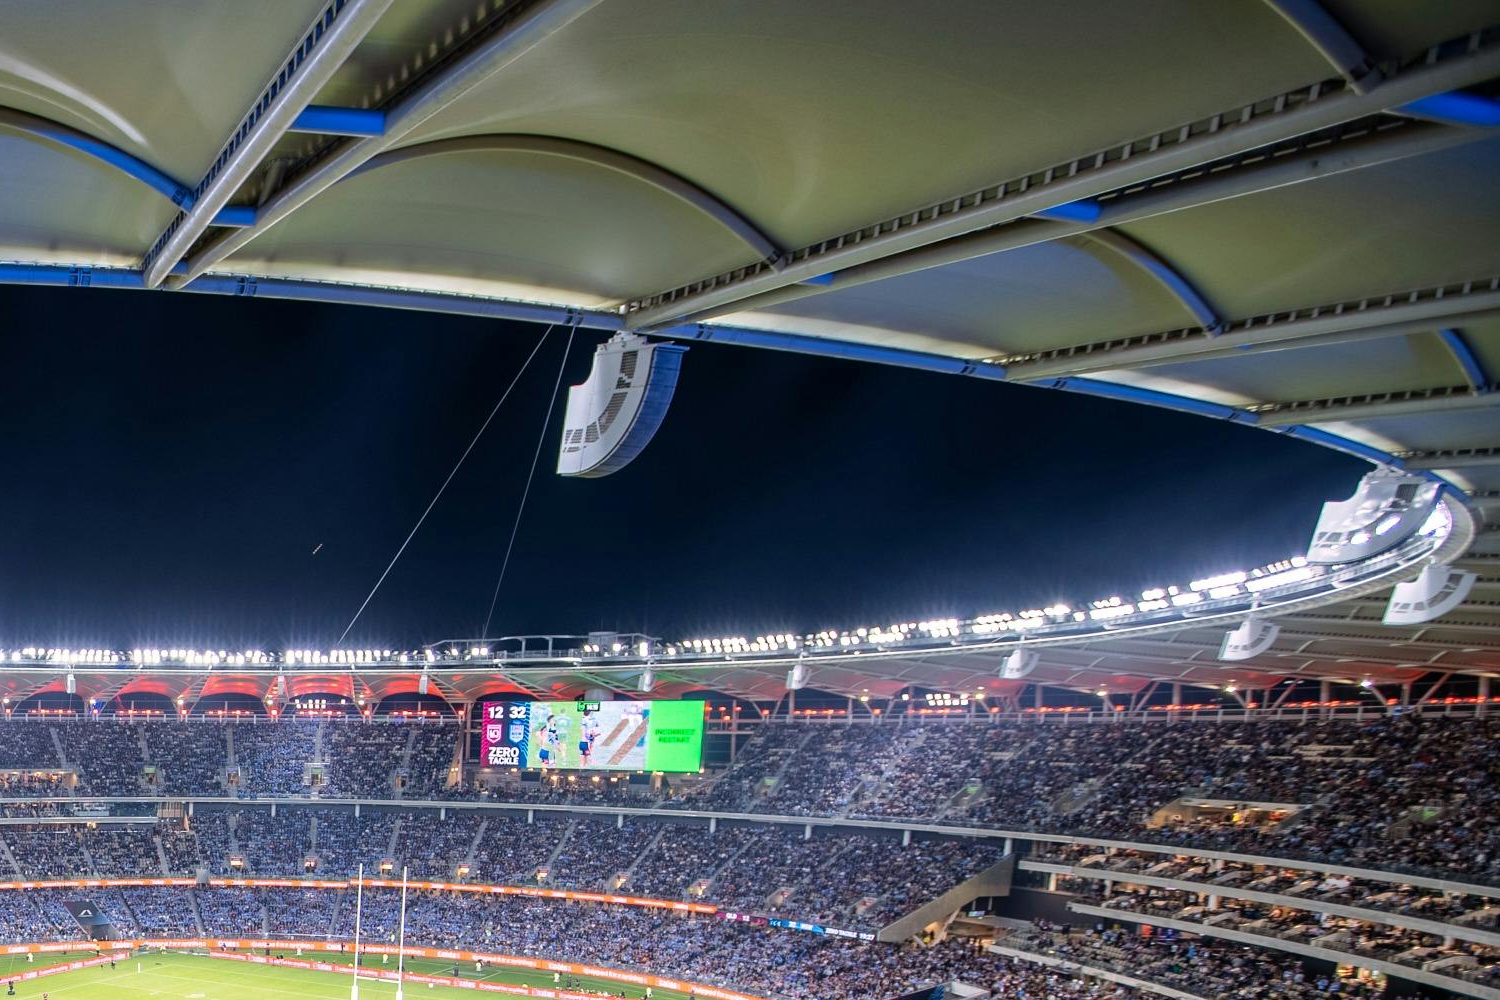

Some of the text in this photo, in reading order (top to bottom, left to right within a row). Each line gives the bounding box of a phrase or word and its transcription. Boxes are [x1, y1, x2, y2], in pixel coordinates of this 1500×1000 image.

[488, 706, 504, 719] 12
[509, 706, 527, 719] 32
[488, 746, 520, 758] ZERO
[488, 757, 519, 765] TACKLE
